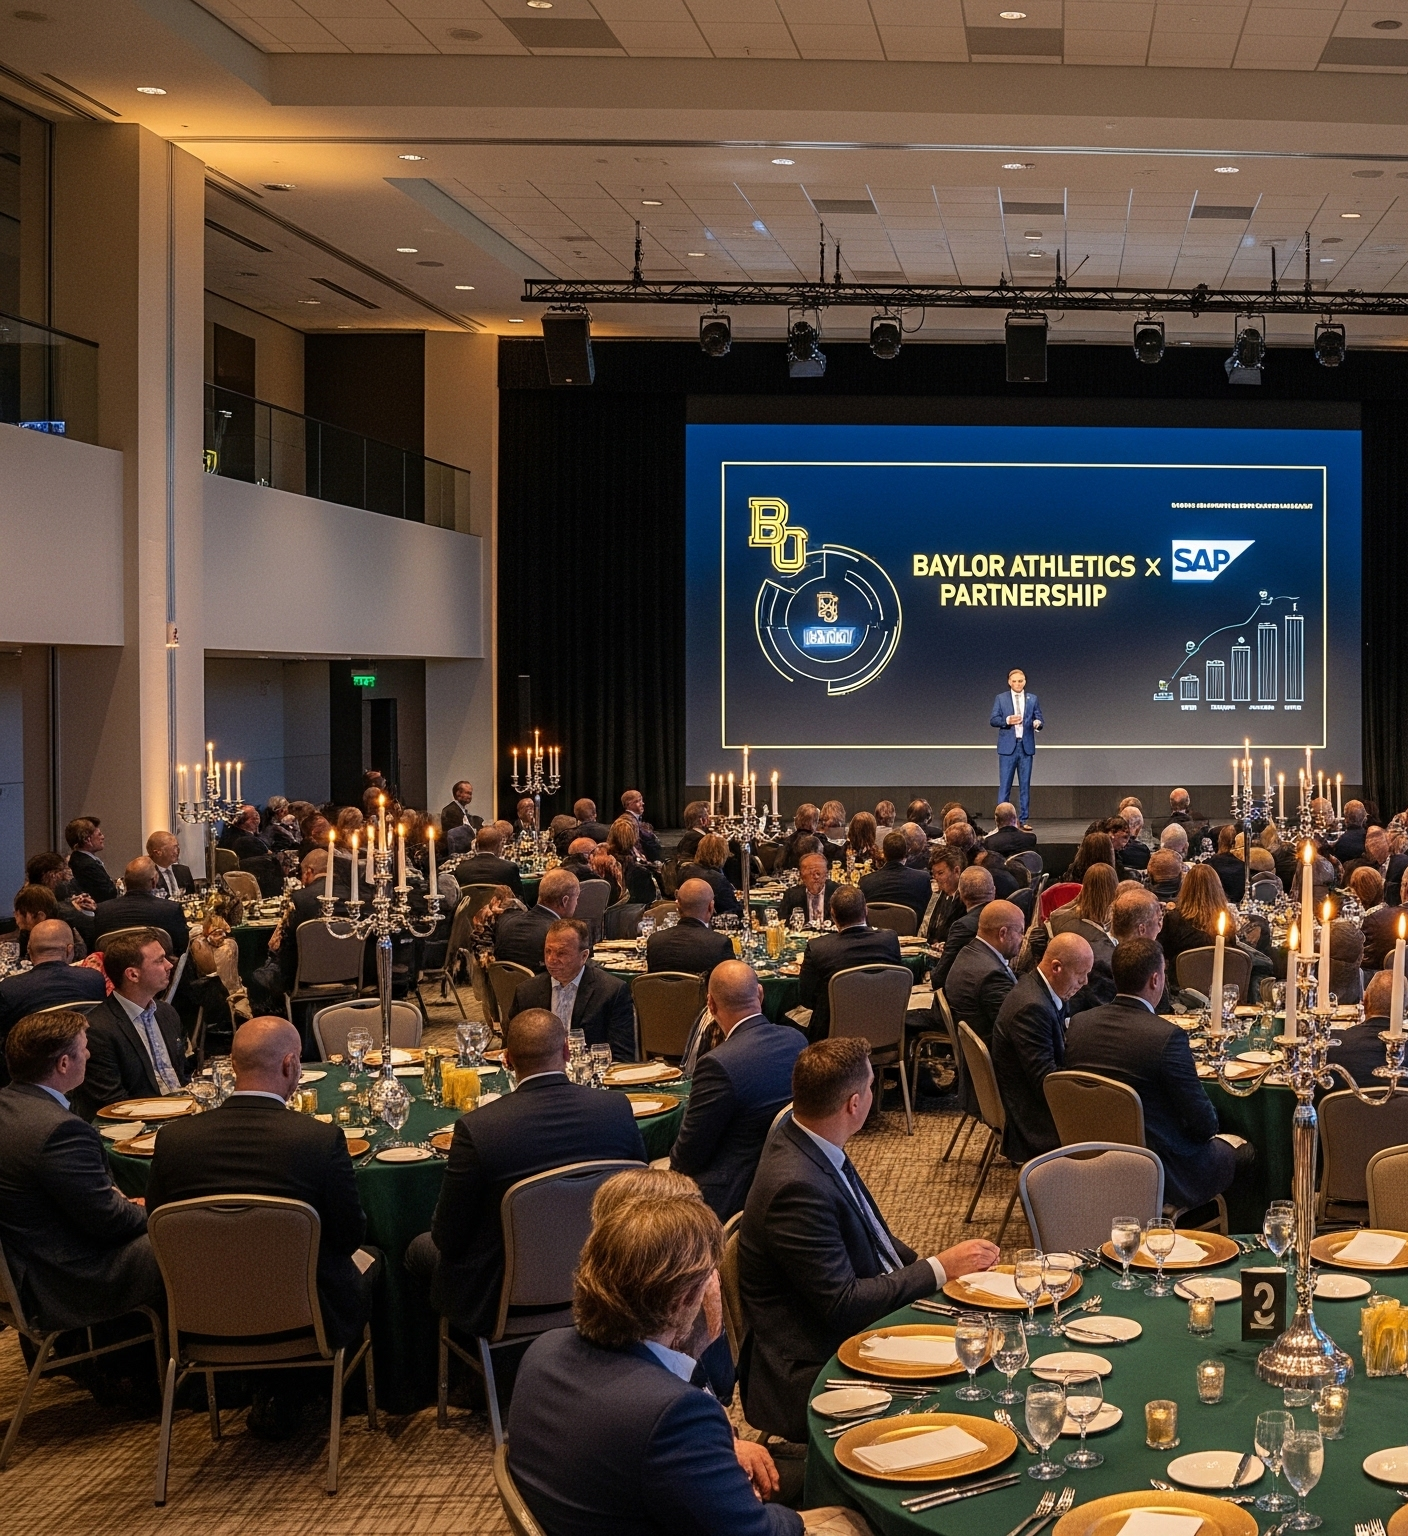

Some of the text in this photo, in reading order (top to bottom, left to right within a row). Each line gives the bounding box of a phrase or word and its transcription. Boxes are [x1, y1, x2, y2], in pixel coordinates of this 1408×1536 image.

[749, 497, 808, 573] BU
[913, 554, 1005, 577] BAYLOR
[1009, 555, 1136, 577] ATHLETICS
[1174, 548, 1231, 572] SAP
[940, 583, 1107, 607] PARTNERSHIP
